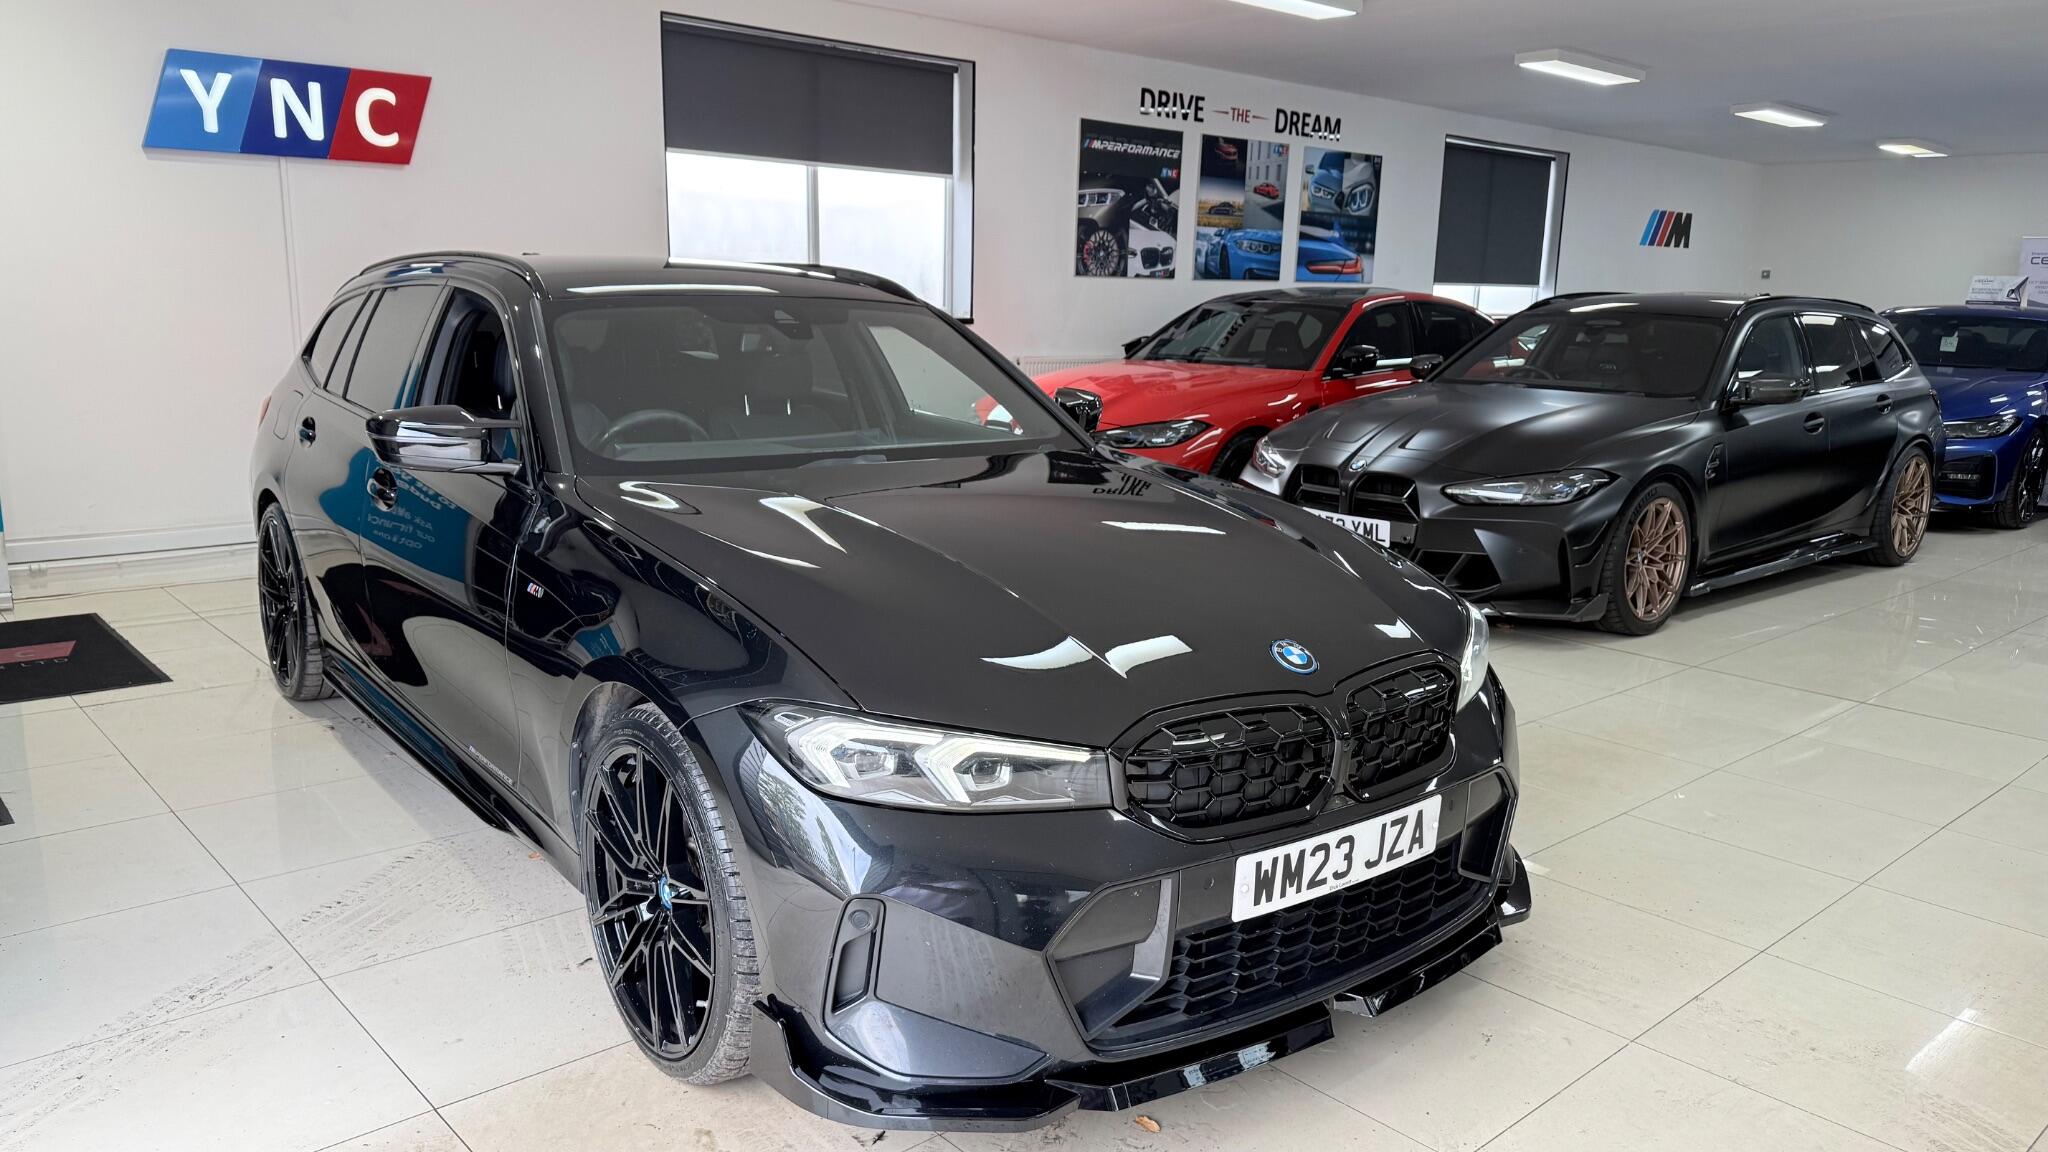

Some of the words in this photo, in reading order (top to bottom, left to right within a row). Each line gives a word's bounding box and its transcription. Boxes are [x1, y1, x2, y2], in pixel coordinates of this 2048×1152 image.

[180, 68, 400, 148] YNC
[1139, 87, 1206, 123] DRIVE
[1230, 106, 1251, 124] THE
[1274, 107, 1342, 142] DREAM
[1253, 834, 1356, 907] WM23
[1364, 808, 1424, 870] JZA
